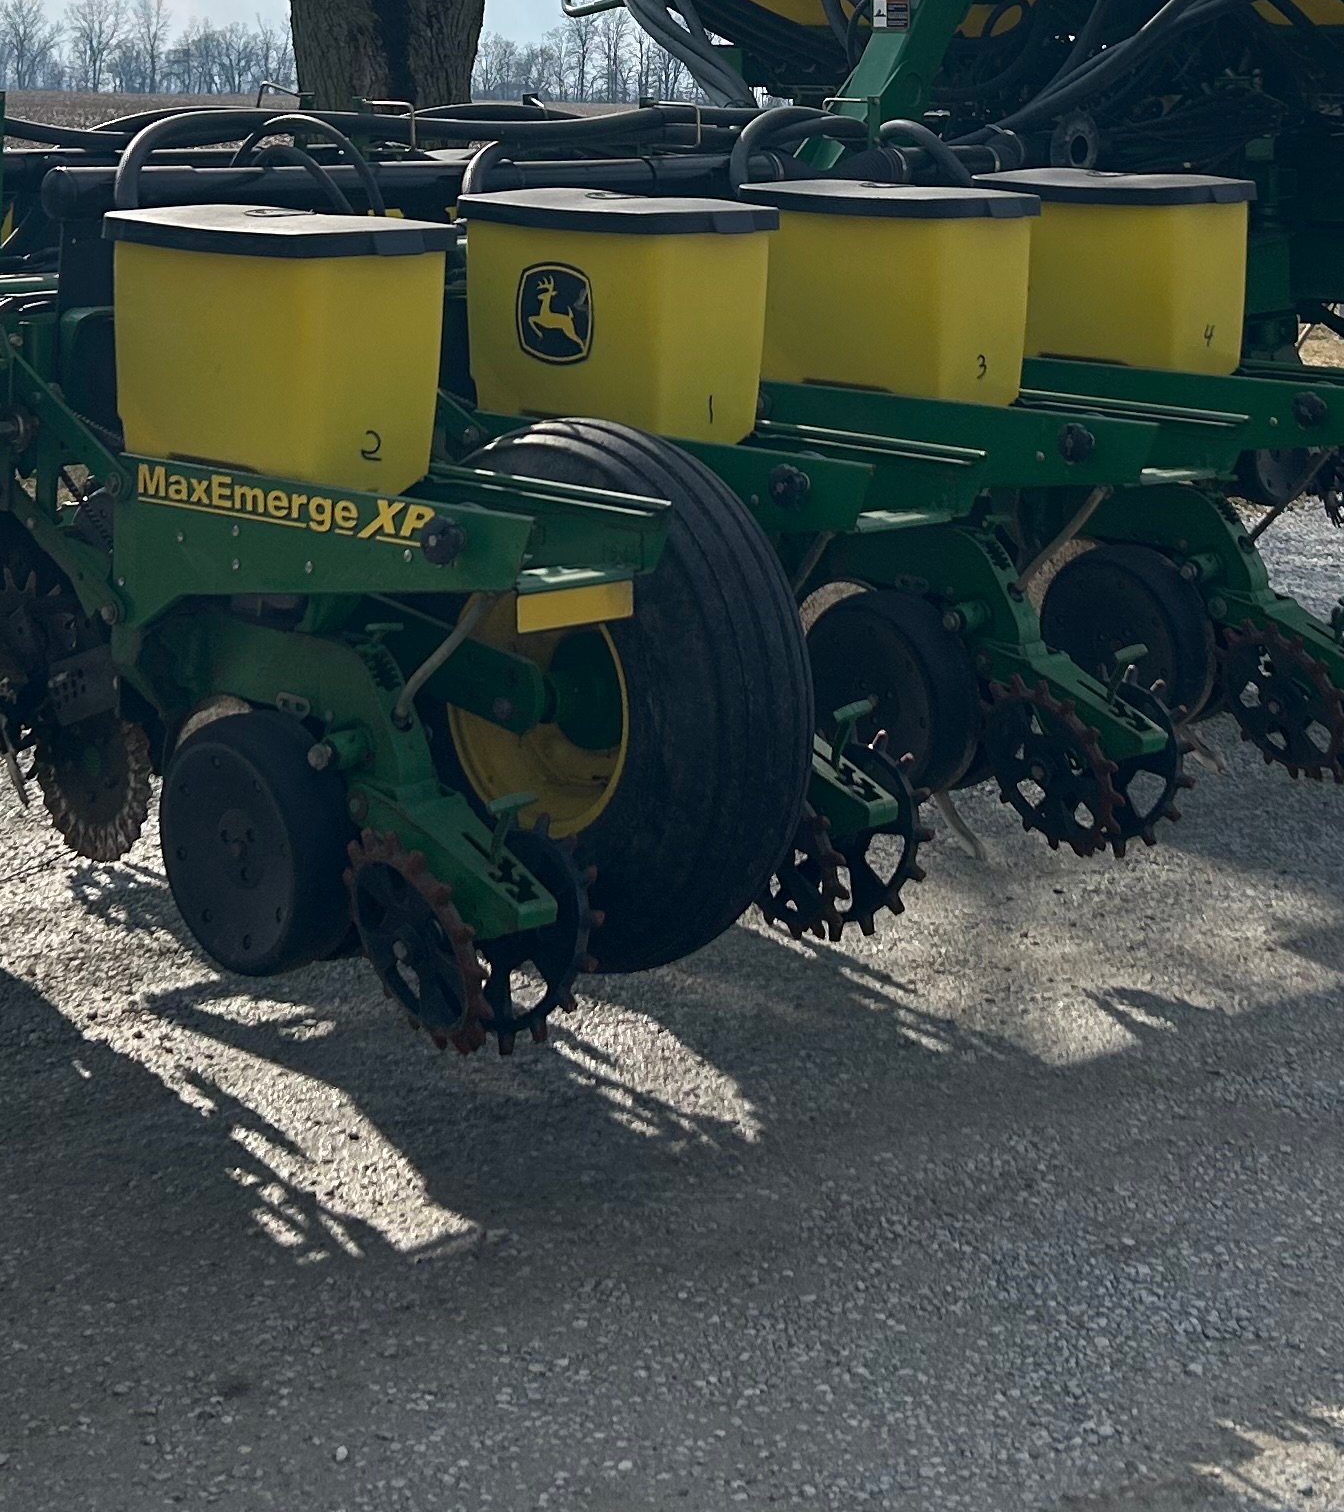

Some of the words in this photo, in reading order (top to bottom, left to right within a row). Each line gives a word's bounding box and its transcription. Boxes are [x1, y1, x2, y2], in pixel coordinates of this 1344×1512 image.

[1204, 324, 1215, 347] 4
[976, 354, 987, 379] 3
[361, 430, 382, 461] 2
[137, 464, 358, 532] MaxEmerge
